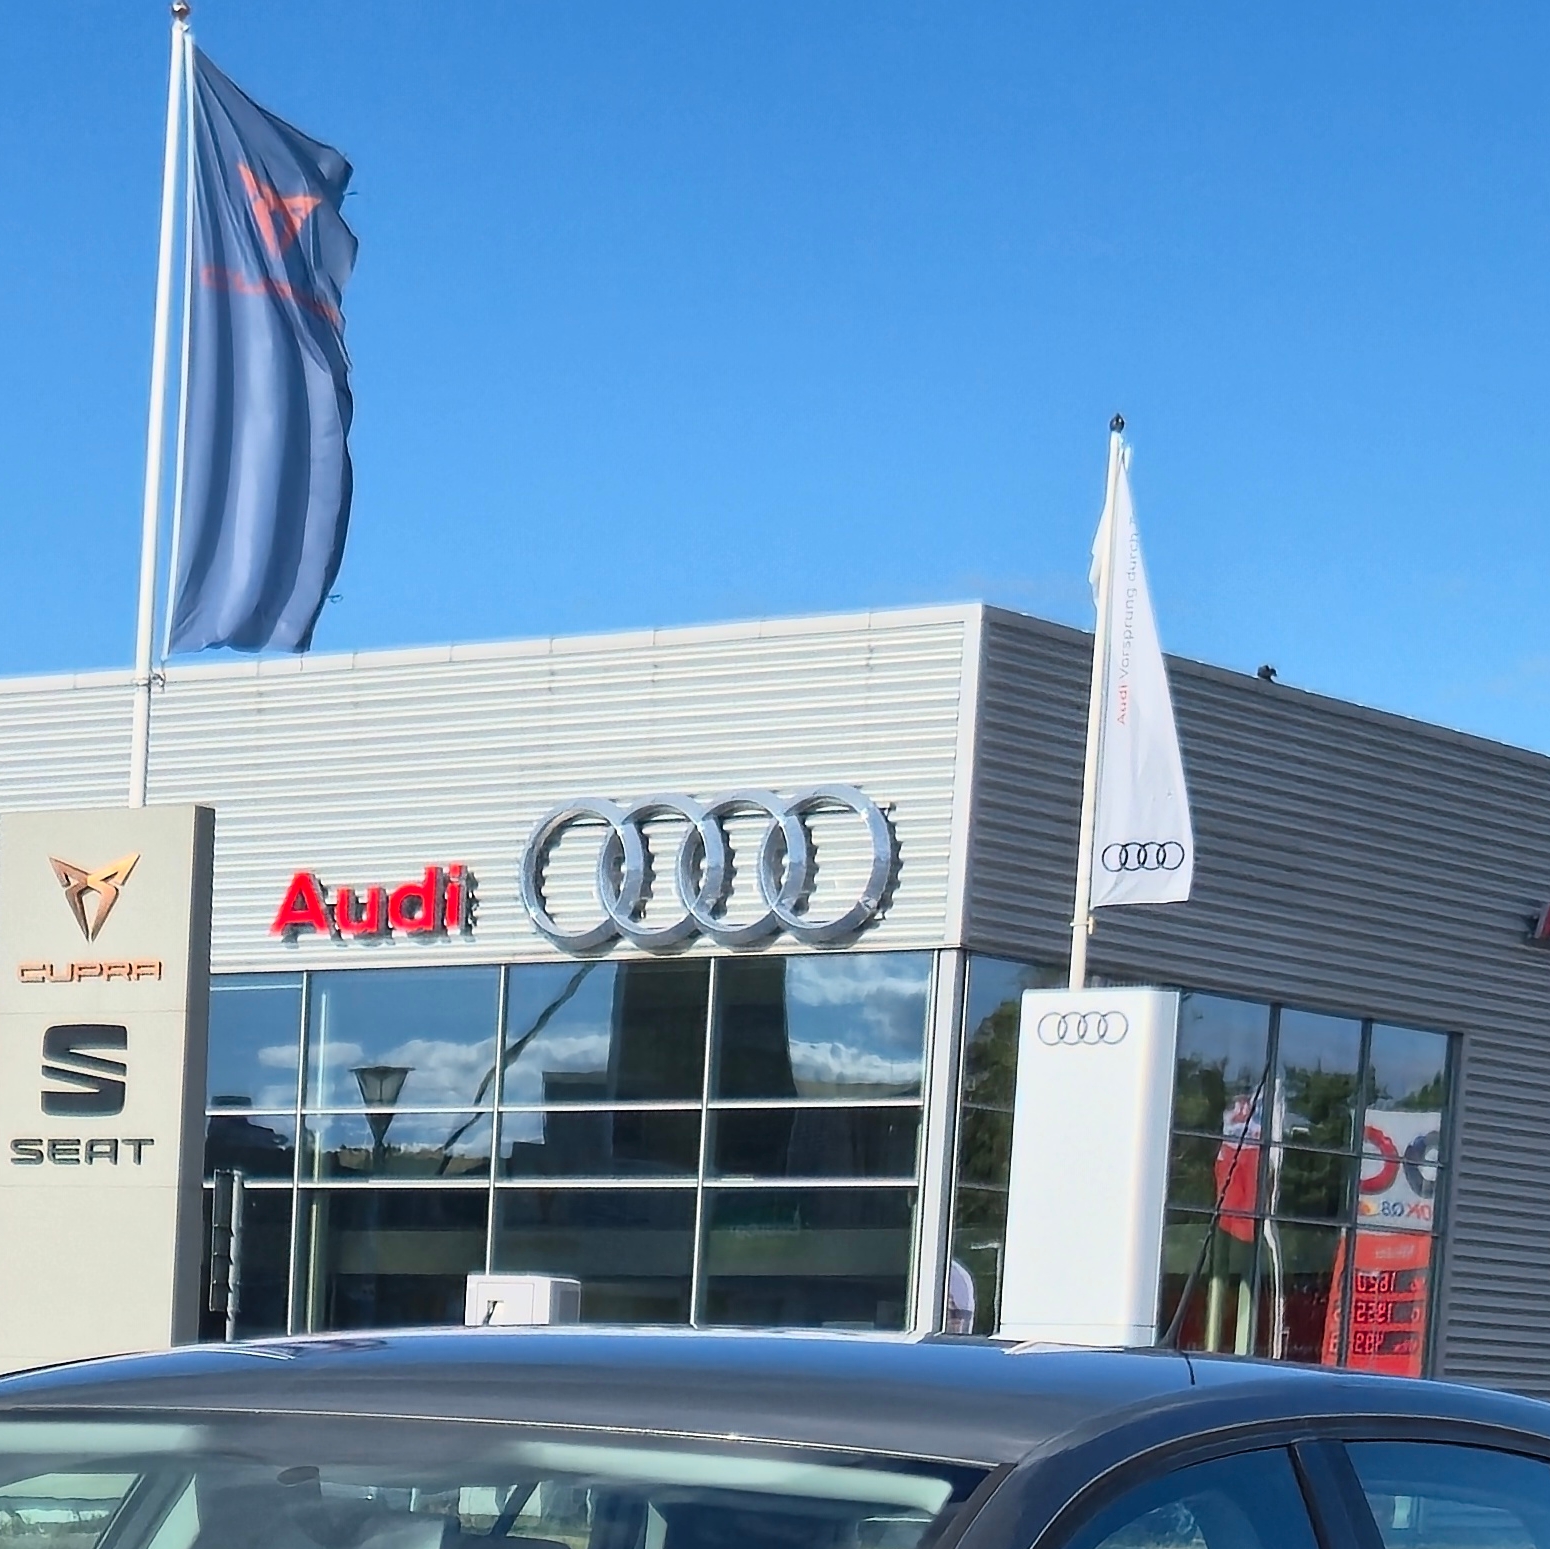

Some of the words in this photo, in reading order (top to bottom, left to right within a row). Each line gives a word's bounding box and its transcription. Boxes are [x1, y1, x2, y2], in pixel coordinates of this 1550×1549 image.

[1118, 586, 1137, 679] Vorsprung
[1116, 682, 1128, 726] Audi
[269, 863, 467, 937] Audi
[18, 959, 164, 984] CUPRA
[10, 1138, 155, 1166] SEAT
